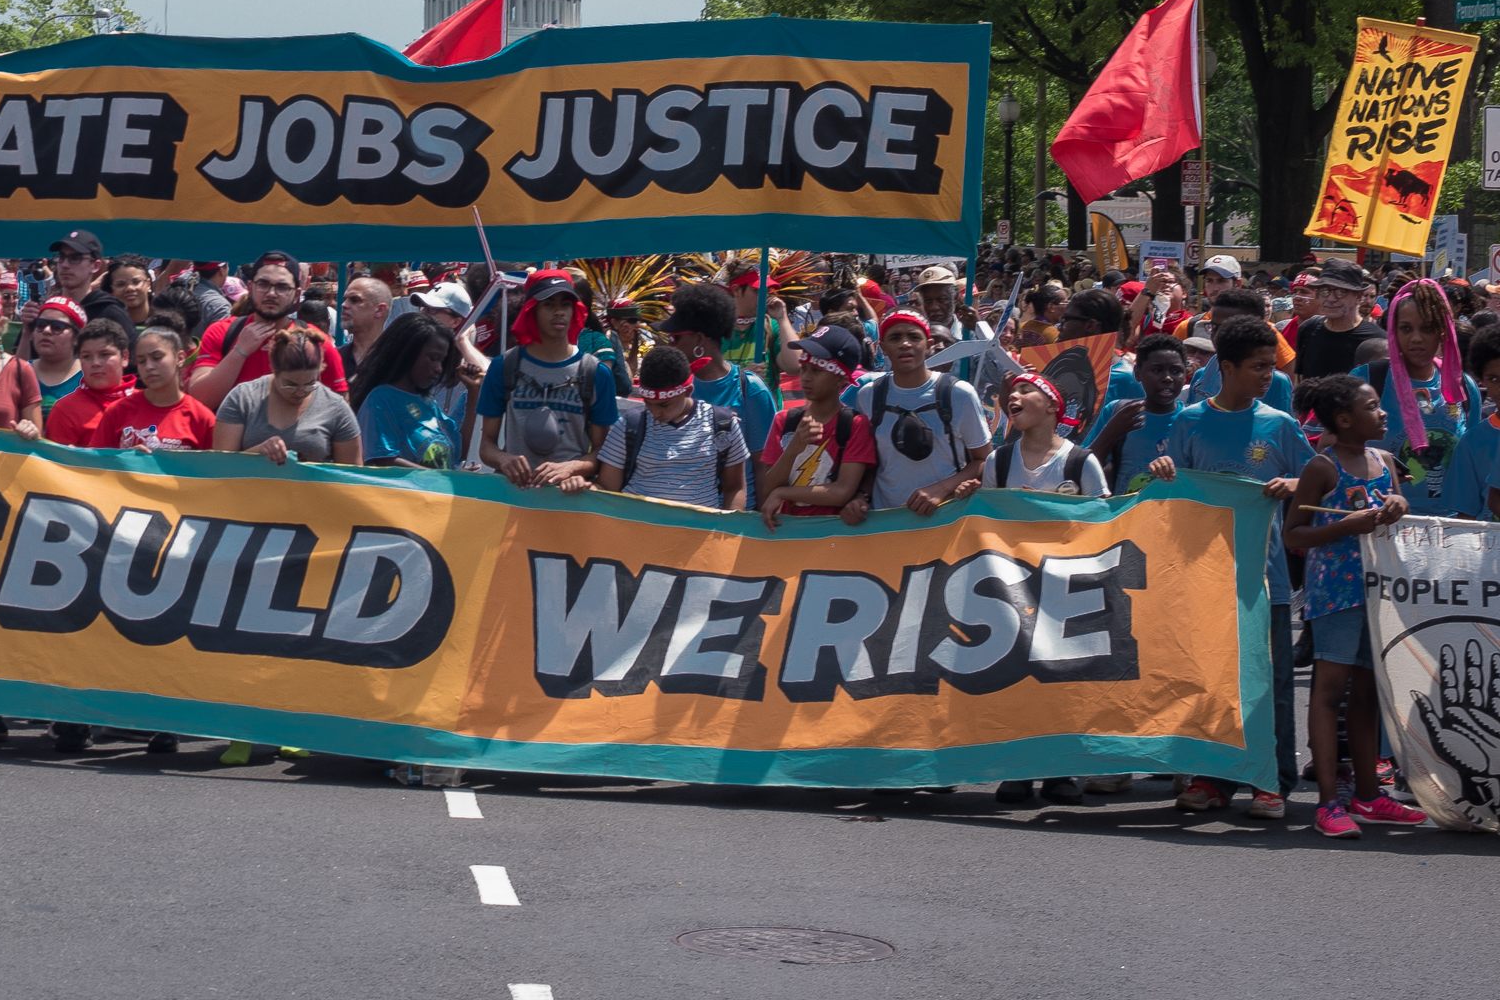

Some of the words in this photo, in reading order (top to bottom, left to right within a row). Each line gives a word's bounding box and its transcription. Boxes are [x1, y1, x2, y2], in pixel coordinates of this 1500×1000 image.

[1456, 0, 1495, 21] Pennsylvania
[1354, 58, 1463, 96] NATIVE
[1347, 90, 1450, 123] NATIONS
[208, 97, 473, 187] JOBS
[511, 86, 930, 177] JUSTICE
[1346, 118, 1447, 161] RISE
[1365, 571, 1469, 606] PEOPLE
[531, 553, 767, 683] WE
[781, 547, 1121, 685] RISE
